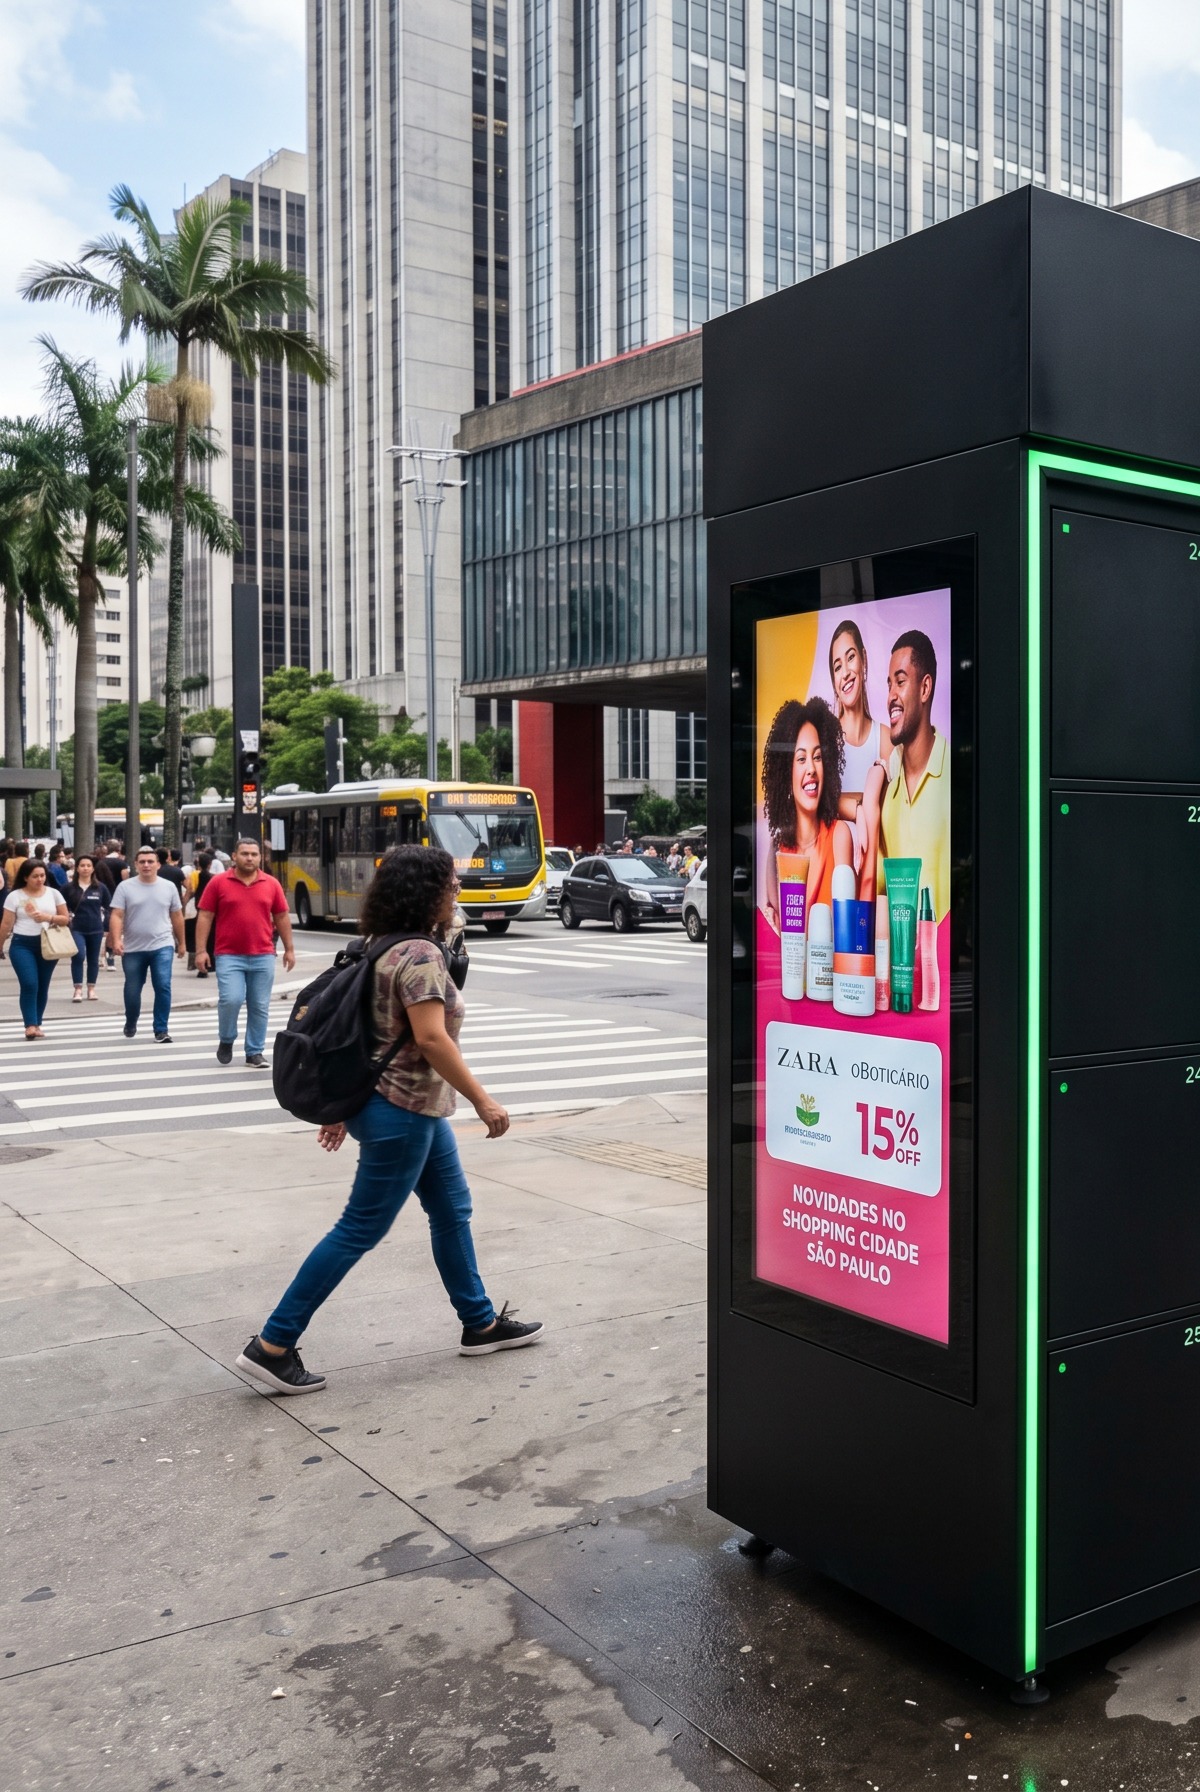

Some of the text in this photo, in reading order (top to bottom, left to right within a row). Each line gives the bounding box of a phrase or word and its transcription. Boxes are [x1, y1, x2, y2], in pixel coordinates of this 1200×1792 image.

[777, 1047, 840, 1077] ZARA
[856, 1102, 919, 1161] 15%
[895, 1148, 921, 1167] OFF
[793, 1183, 906, 1232] NOVIDADES NO
[782, 1208, 919, 1265] SHOPPING CIDADE
[807, 1240, 891, 1286] SÃO PAULO
